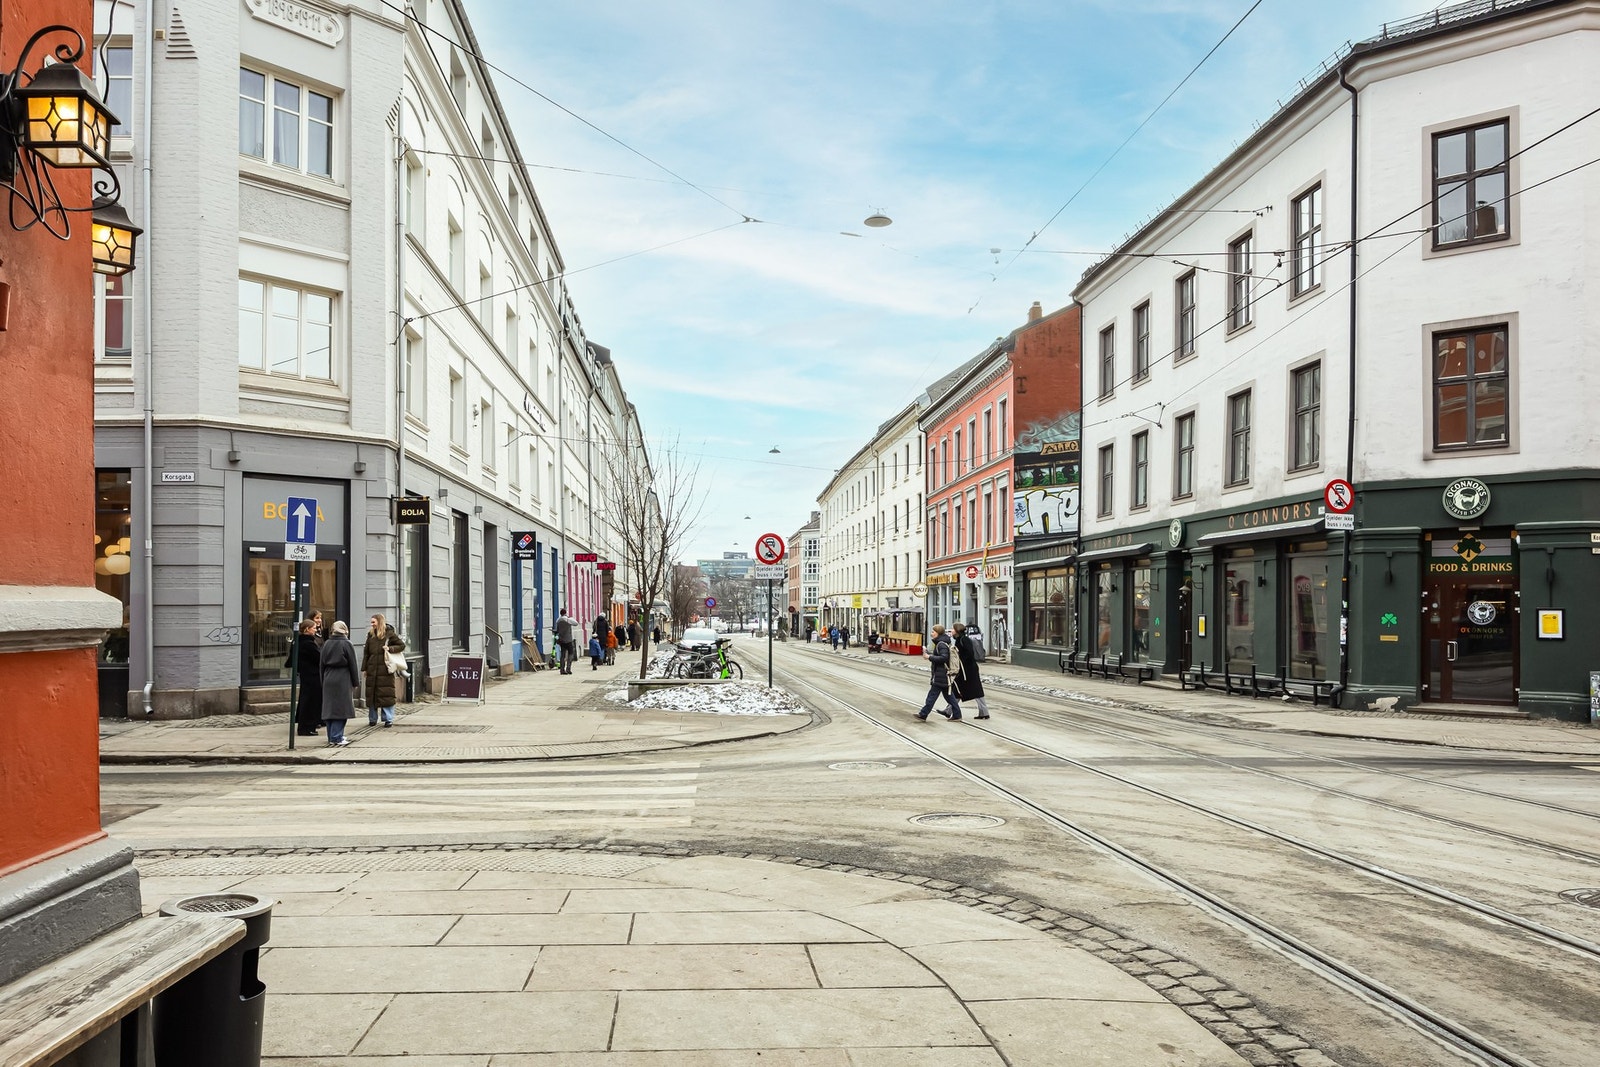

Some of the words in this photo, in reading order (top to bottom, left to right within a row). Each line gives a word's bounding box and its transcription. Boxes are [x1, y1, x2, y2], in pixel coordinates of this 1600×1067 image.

[164, 473, 192, 481] Korsgata
[263, 501, 325, 522] BOA
[401, 508, 425, 516] BOLIA
[576, 554, 597, 562] evo
[1430, 563, 1458, 572] FOOD
[1461, 563, 1469, 572] &
[1472, 562, 1513, 572] DRINKS
[451, 670, 479, 680] SALE
